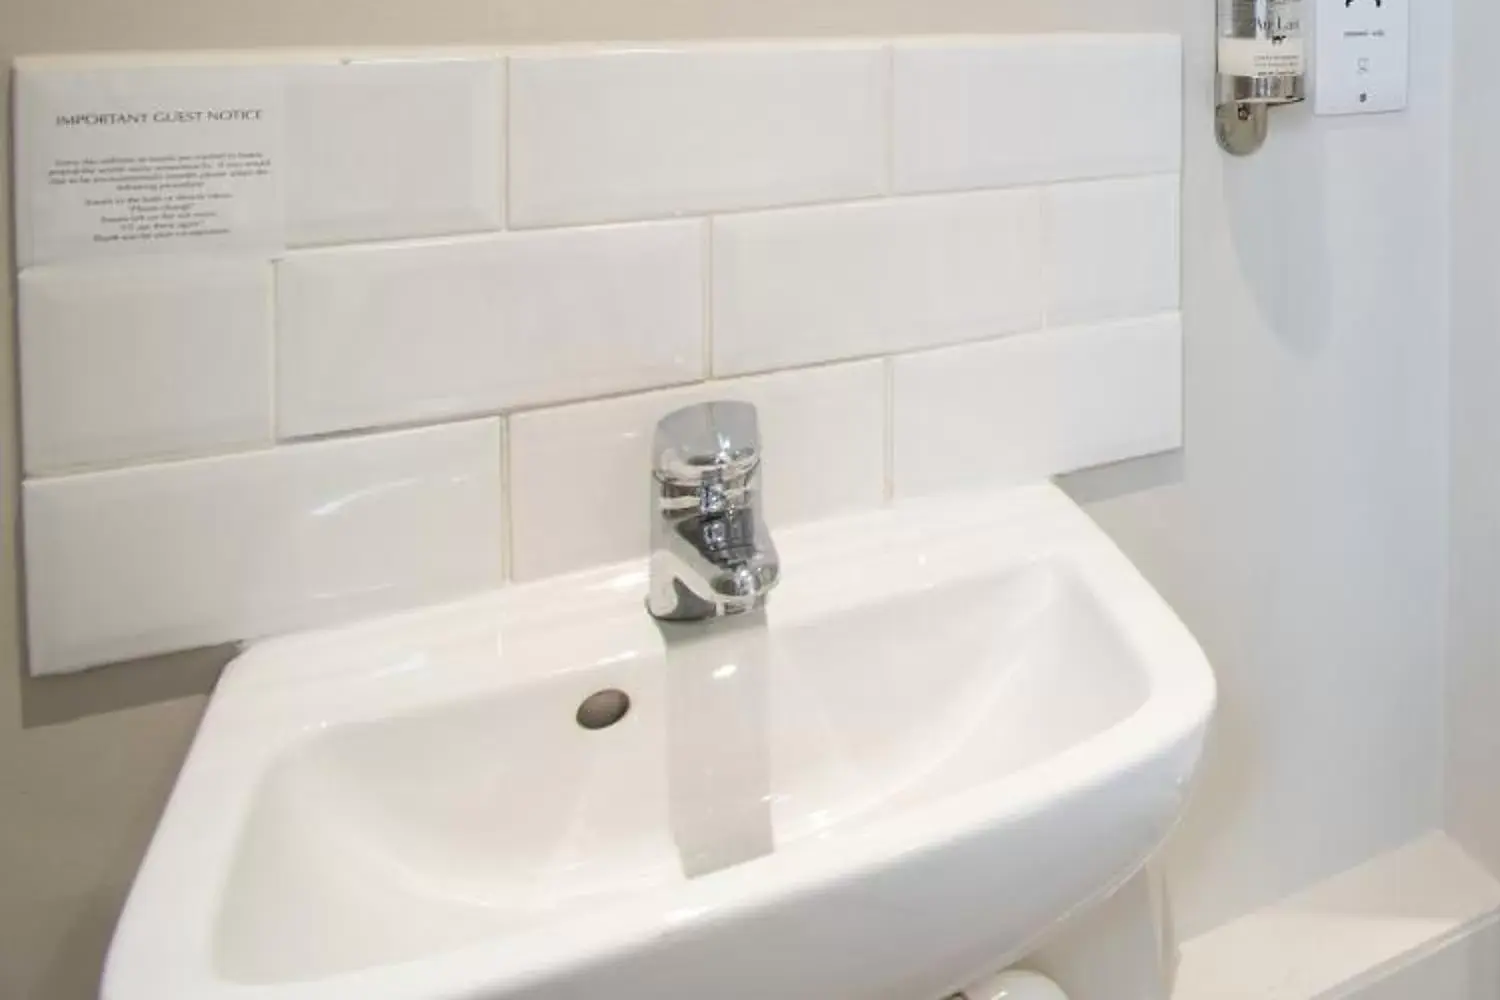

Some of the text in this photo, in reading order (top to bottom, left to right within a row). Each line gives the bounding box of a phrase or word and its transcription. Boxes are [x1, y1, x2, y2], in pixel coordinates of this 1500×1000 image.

[55, 108, 263, 126] IMPORTANT GUEST NOTICE
